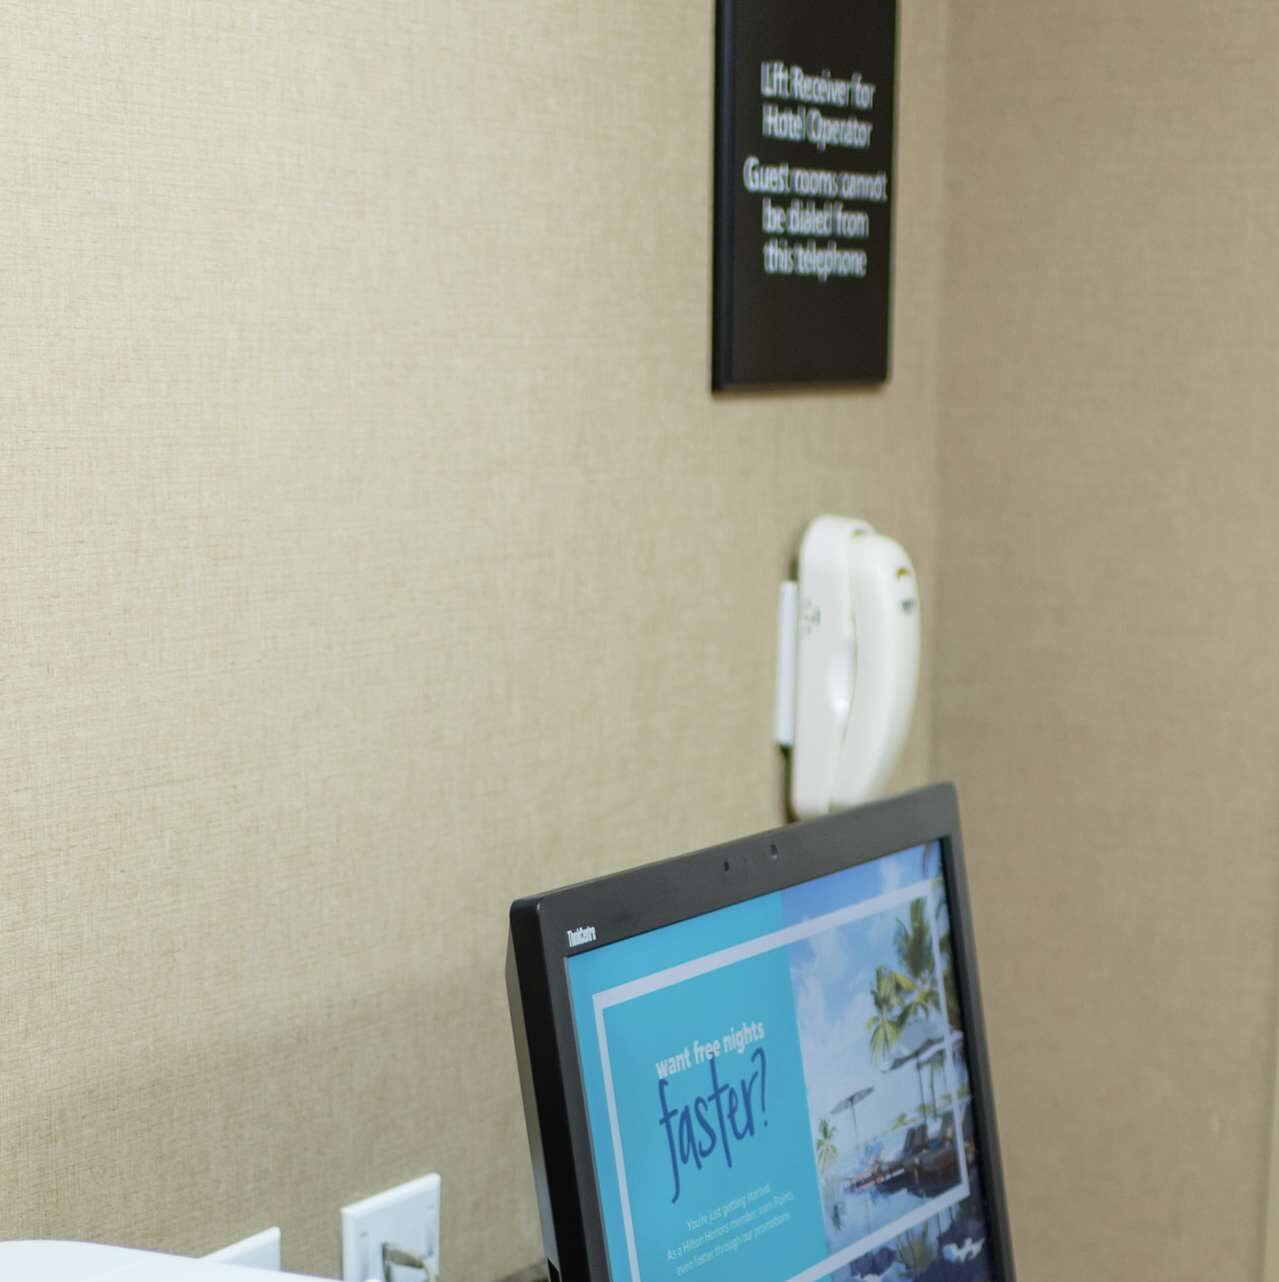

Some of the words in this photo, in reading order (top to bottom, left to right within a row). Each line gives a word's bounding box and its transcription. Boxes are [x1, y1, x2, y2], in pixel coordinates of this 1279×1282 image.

[761, 61, 789, 97] Lift
[790, 65, 849, 108] Receiver
[851, 72, 877, 110] for
[762, 103, 806, 142] Hotel
[807, 109, 873, 153] Operator
[742, 156, 791, 193] Guest
[791, 168, 839, 198] rooms
[839, 171, 888, 202] cannot
[762, 196, 785, 234] be
[786, 199, 833, 238] dialed
[834, 201, 870, 239] from
[763, 239, 794, 274] this
[794, 240, 868, 283] telephone
[656, 1048, 691, 1079] want
[692, 1040, 720, 1064] free
[722, 1021, 765, 1054] nights
[658, 1047, 769, 1205] faster?
